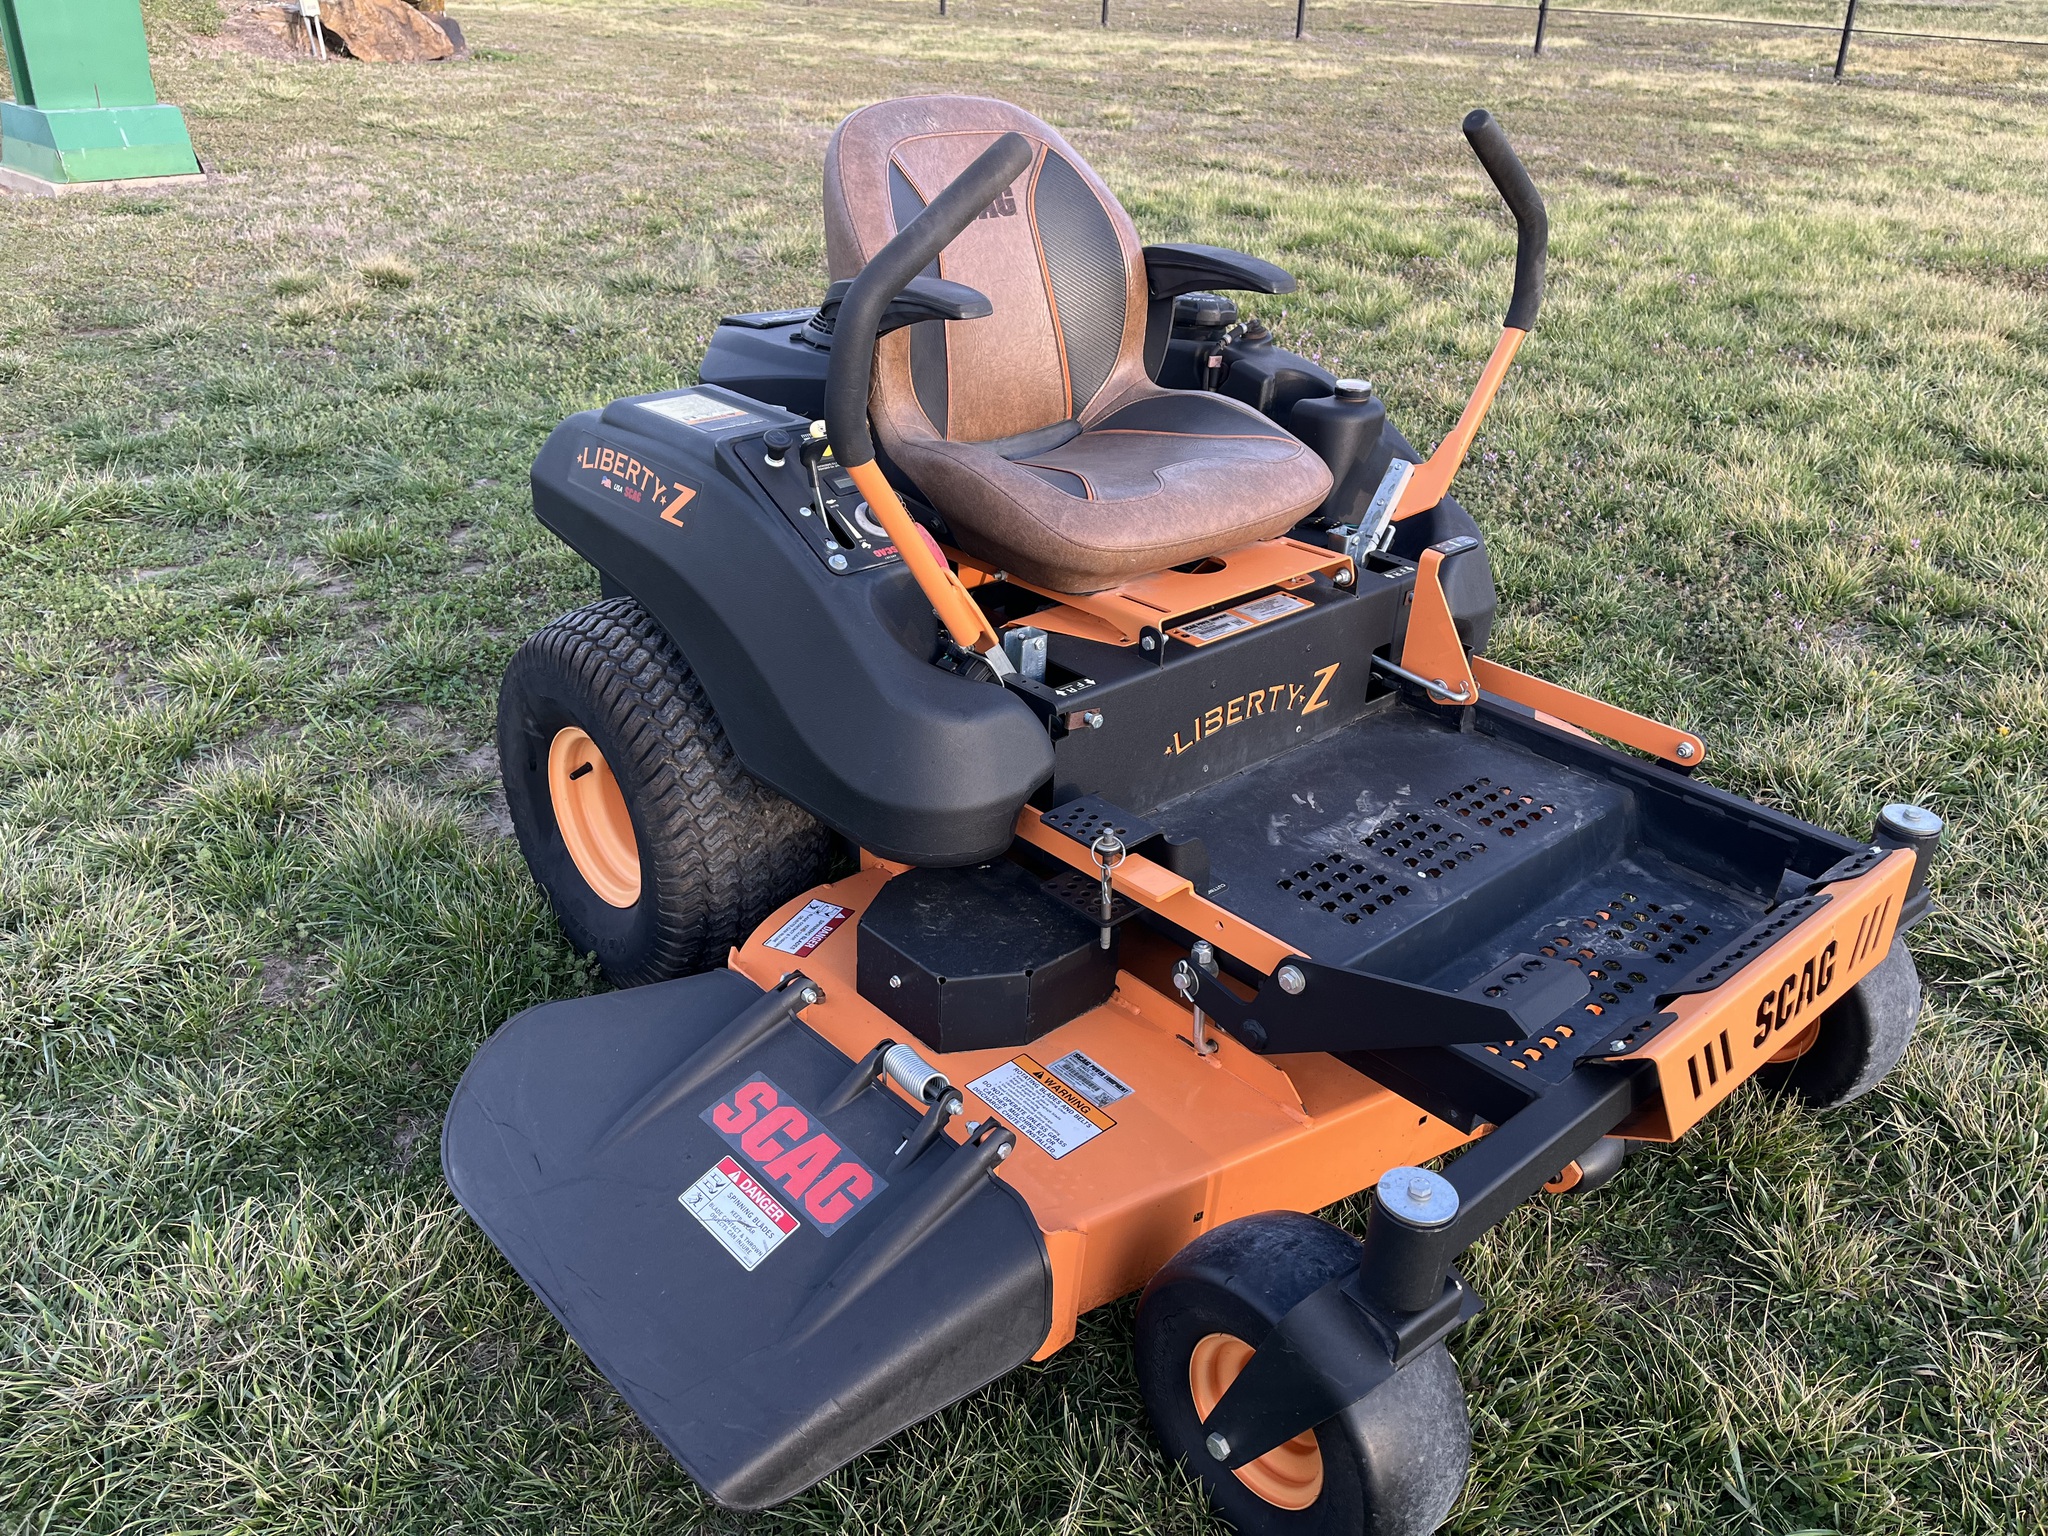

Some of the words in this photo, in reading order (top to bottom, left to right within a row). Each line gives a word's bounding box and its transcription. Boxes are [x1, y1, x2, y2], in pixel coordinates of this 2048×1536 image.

[581, 447, 667, 503] LIBERTY
[660, 482, 697, 528] Z
[613, 483, 623, 493] USA
[624, 486, 642, 503] SCAG
[1173, 683, 1304, 755] LIBERTY
[1301, 662, 1341, 716] Z
[804, 926, 833, 948] DANGER
[1753, 940, 1838, 1049] SCAG
[972, 1087, 1002, 1110] DISCHARGE
[1001, 1110, 1020, 1124] CHUTE
[1025, 1129, 1056, 1153] INSTALLED
[990, 1087, 1003, 1096] NOT
[1002, 1096, 1027, 1115] OPERATE
[1025, 1115, 1048, 1132] UNLESS
[1047, 1132, 1067, 1147] GRASS
[1012, 1067, 1040, 1088] ROTATING
[1038, 1087, 1062, 1104] BLADES
[1060, 1104, 1075, 1114] AND
[1073, 1114, 1093, 1128] BELTS
[1042, 1078, 1091, 1113] WARNING
[1007, 1108, 1037, 1130] MULCHING
[1035, 1130, 1046, 1138] KIT
[1045, 1137, 1056, 1145] OR
[713, 1081, 873, 1224] SCAG
[727, 1192, 753, 1218] SPINNING
[752, 1216, 775, 1238] BLADES
[738, 1178, 785, 1222] DANGER
[708, 1202, 723, 1216] BLADE
[721, 1215, 740, 1234] CONTACT
[743, 1236, 763, 1256] THROWN
[709, 1212, 727, 1230] OBJECTS
[726, 1229, 736, 1239] CAN
[735, 1238, 752, 1254] INJURE
